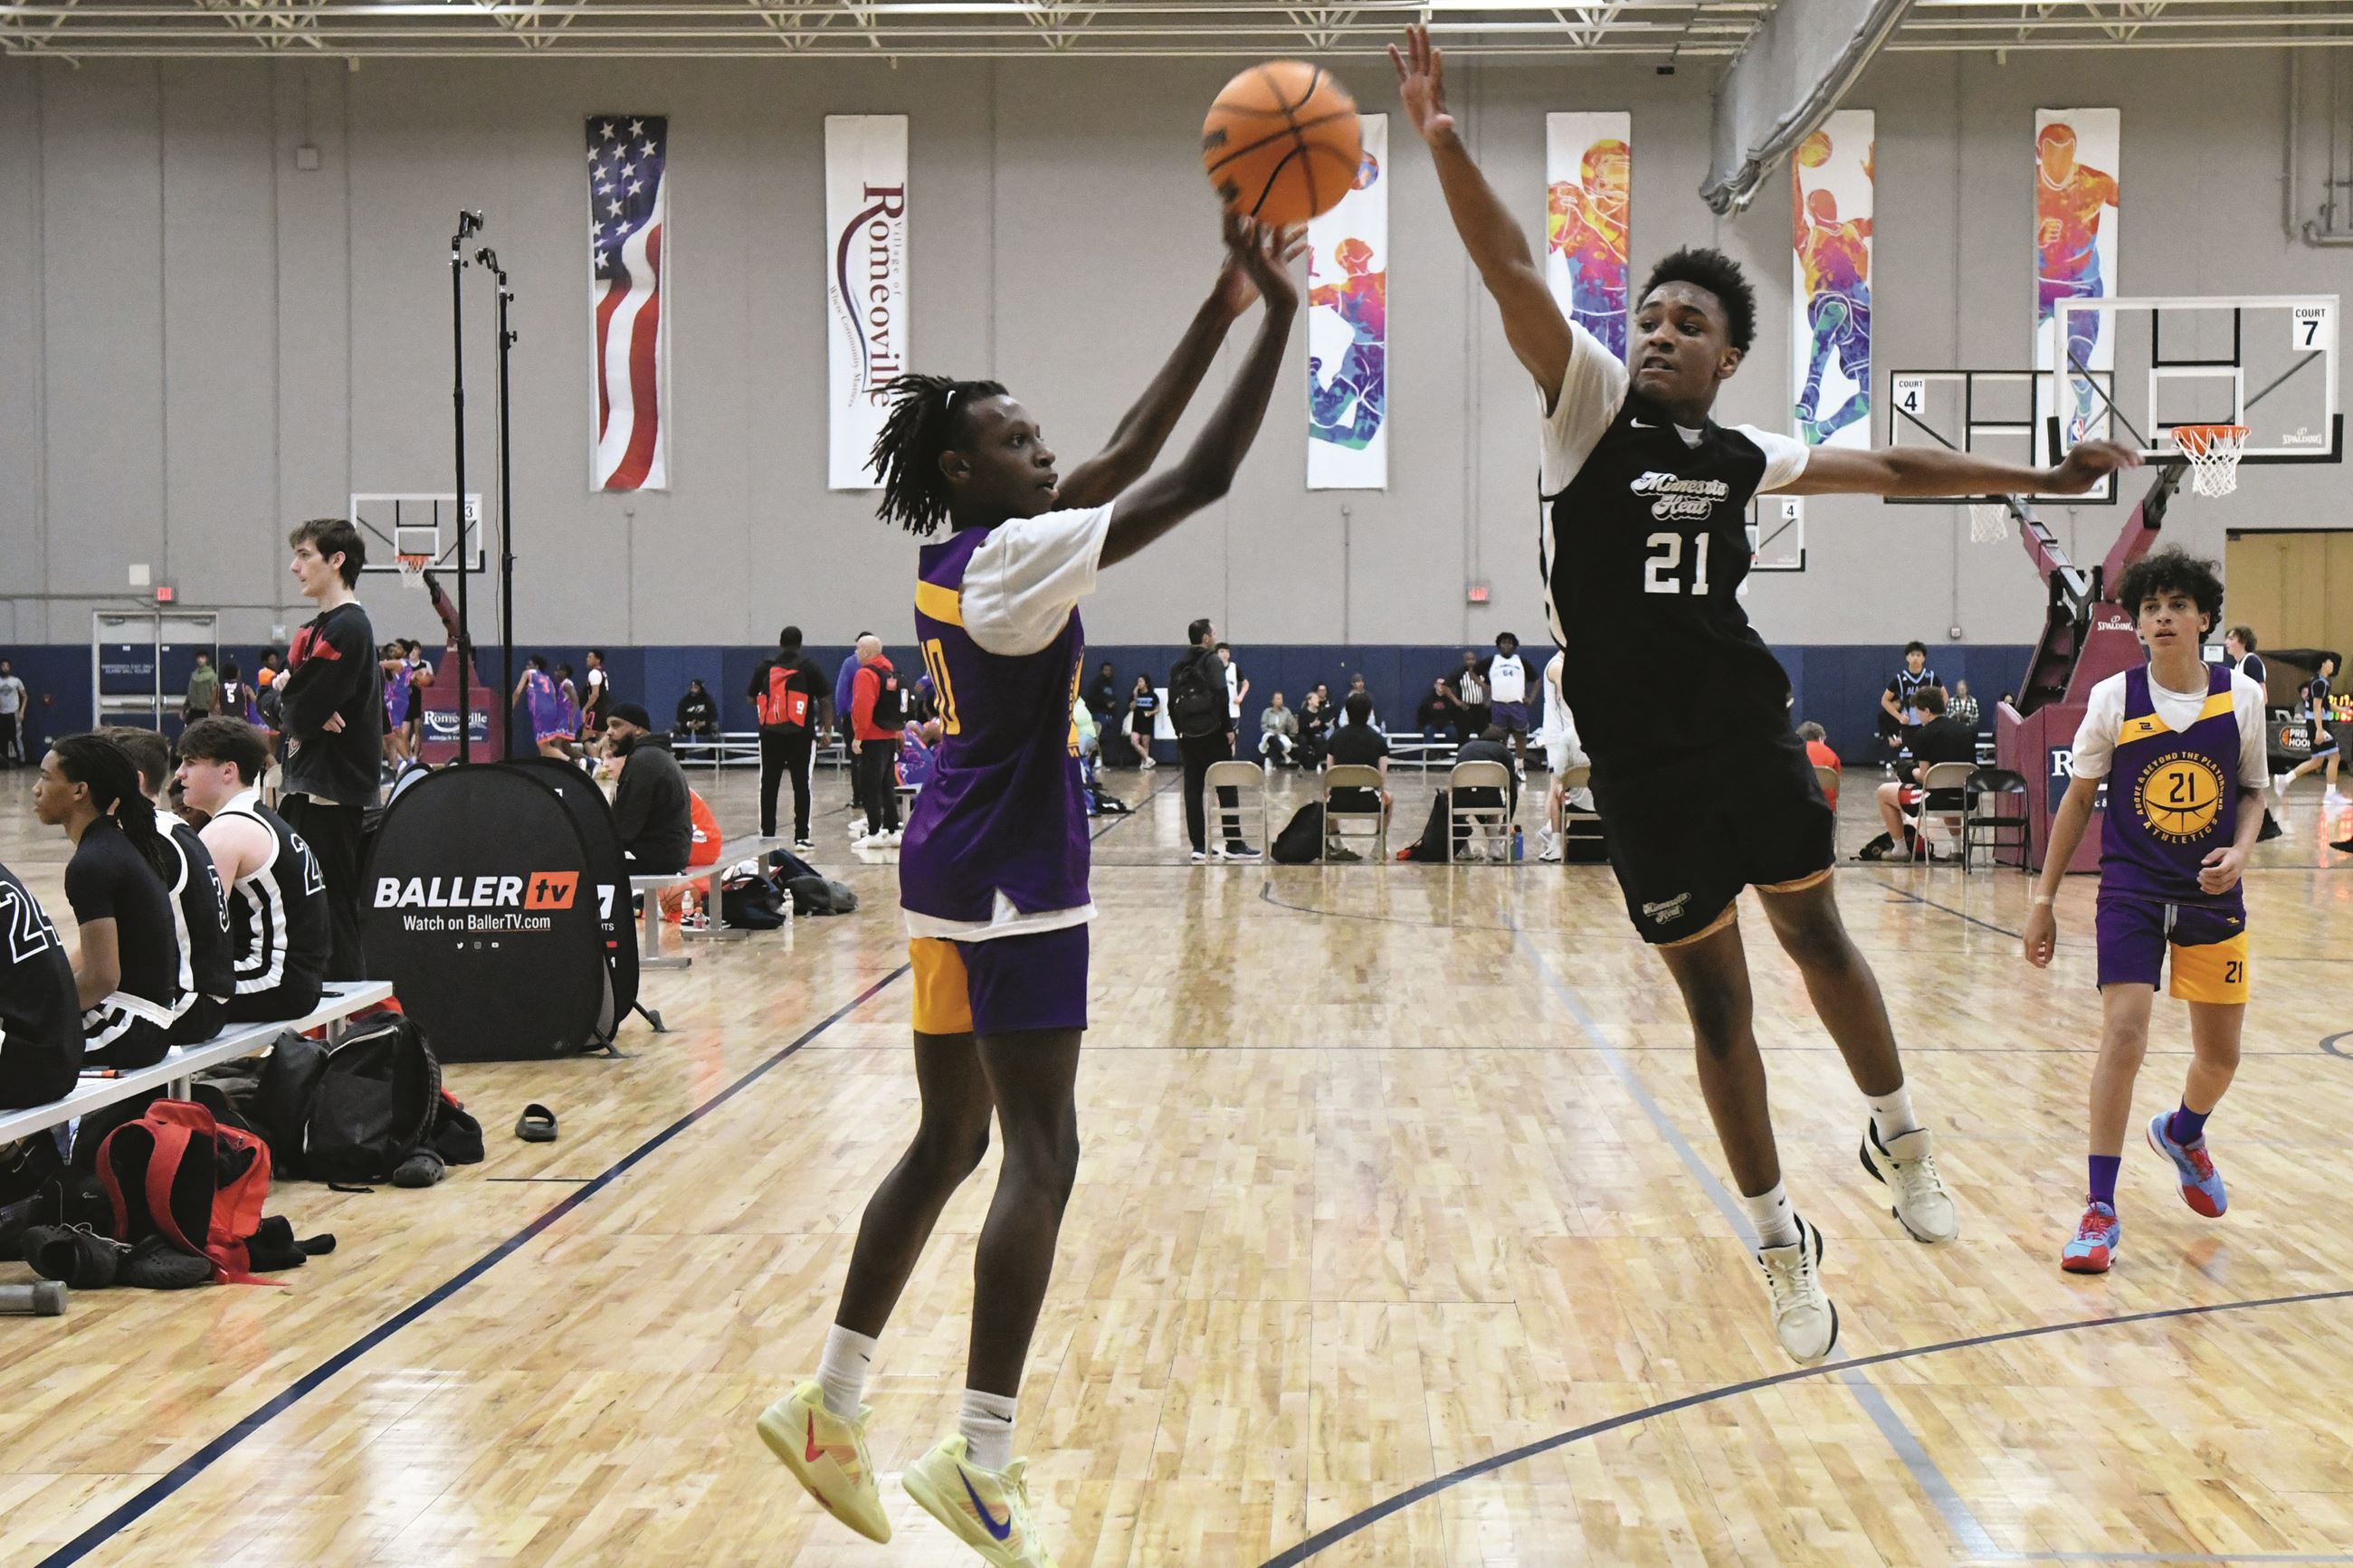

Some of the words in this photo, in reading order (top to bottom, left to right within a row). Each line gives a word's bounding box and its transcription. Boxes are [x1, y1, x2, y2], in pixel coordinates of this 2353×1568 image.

[891, 221, 902, 273] Village
[863, 181, 904, 407] Romeoville
[2295, 309, 2326, 318] COURT
[2302, 320, 2319, 346] 7
[1899, 380, 1922, 388] COURT
[1904, 391, 1918, 411] 4
[2282, 434, 2322, 444] SPALDING
[1630, 470, 1729, 502] Minnesota
[1652, 495, 1712, 521] Heat
[1786, 505, 1795, 517] 4
[1644, 532, 1710, 595] 21
[2097, 621, 2134, 632] SPALDING
[424, 710, 488, 725] Romeille
[2134, 784, 2143, 815] ABOVE
[2143, 752, 2178, 776] BEYOND
[2182, 751, 2200, 760] THE
[2169, 772, 2195, 803] 21
[2143, 817, 2218, 844] ATHLETICS
[374, 876, 524, 908] BALLER
[535, 879, 569, 902] tv
[404, 915, 444, 931] Watch
[448, 917, 463, 930] on
[468, 913, 551, 931] BallerTV.com
[2225, 961, 2243, 983] 21
